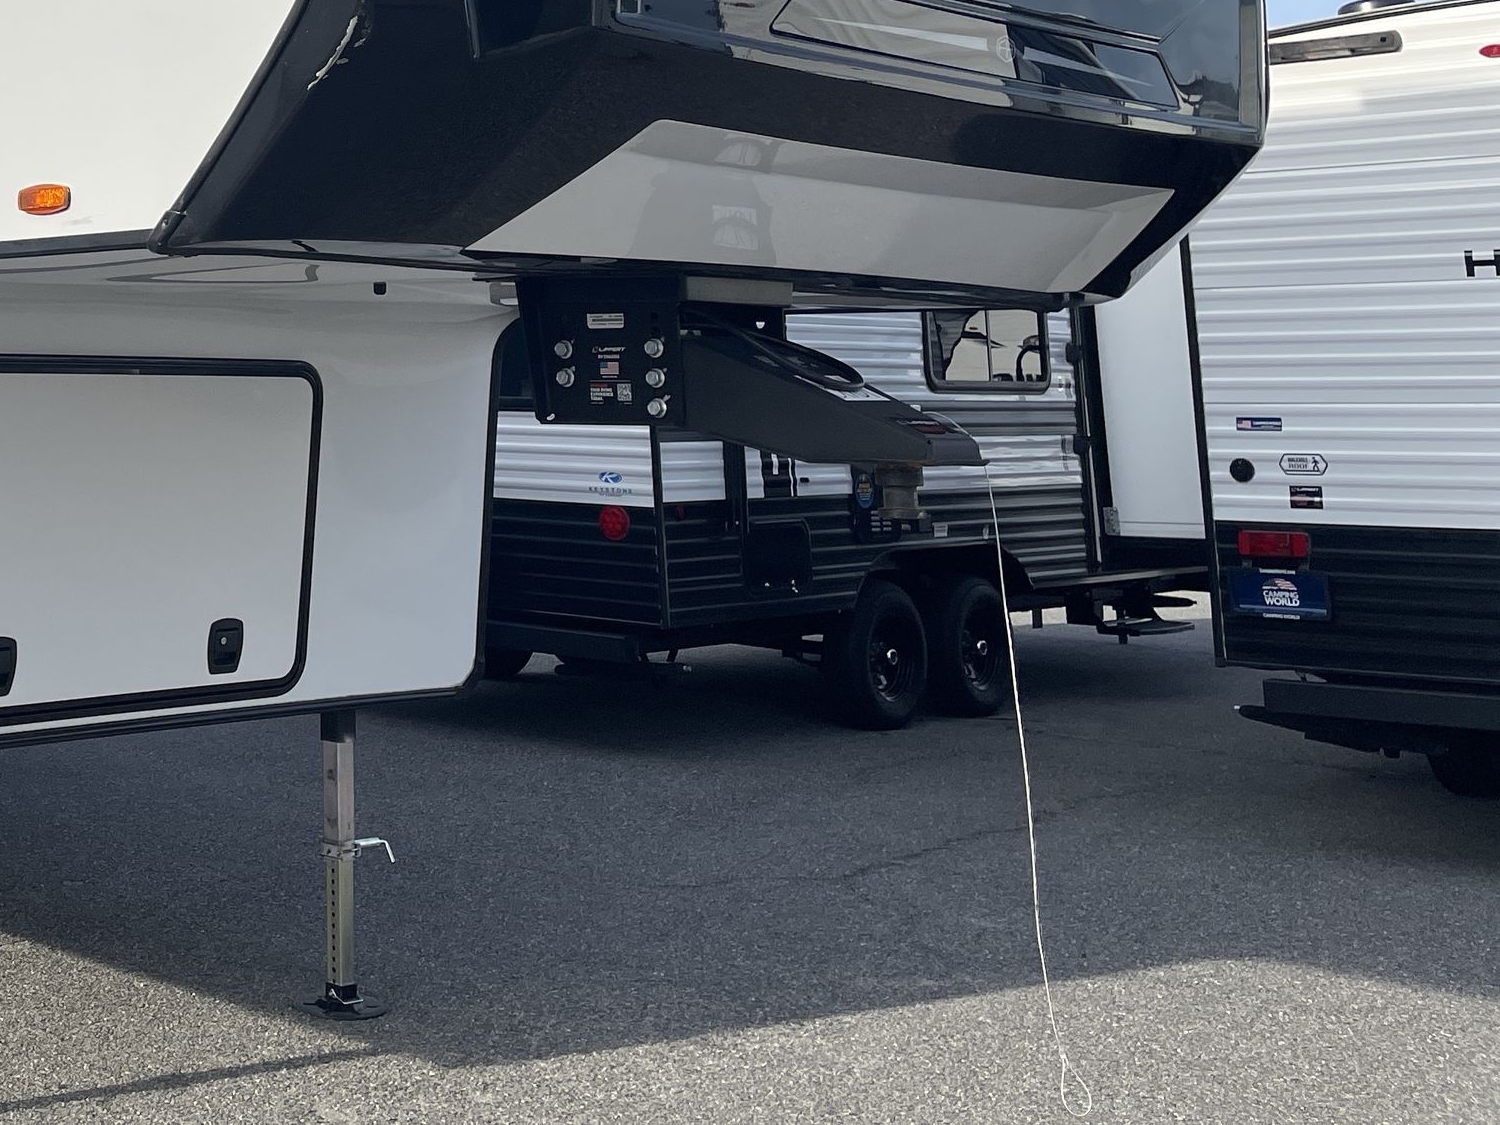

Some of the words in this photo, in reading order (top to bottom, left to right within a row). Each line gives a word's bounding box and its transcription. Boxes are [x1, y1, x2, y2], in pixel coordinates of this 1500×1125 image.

[589, 486, 632, 494] KEYSTONE
[1263, 590, 1299, 599] CAMPING
[1264, 597, 1300, 607] WORLD
